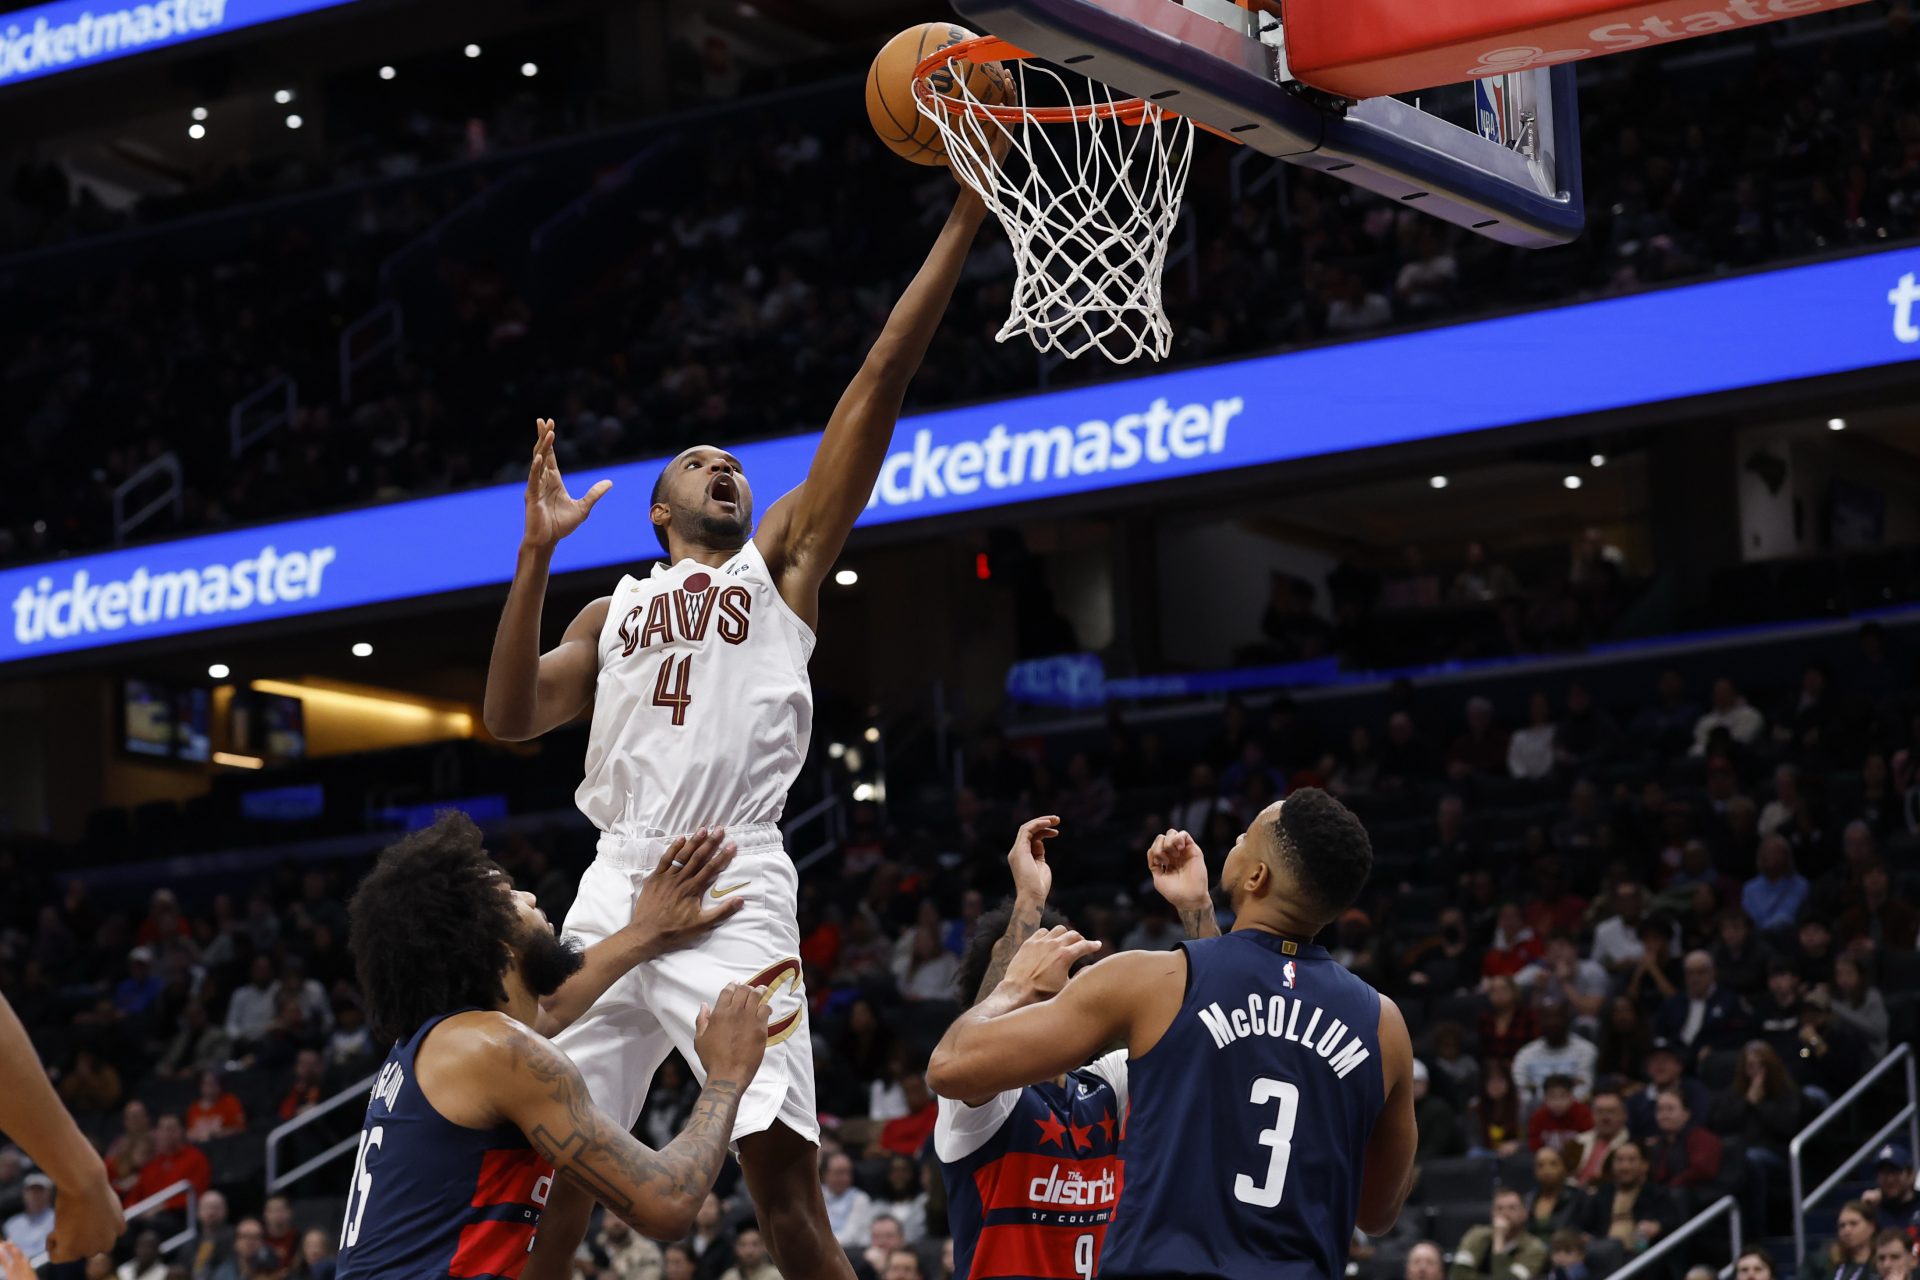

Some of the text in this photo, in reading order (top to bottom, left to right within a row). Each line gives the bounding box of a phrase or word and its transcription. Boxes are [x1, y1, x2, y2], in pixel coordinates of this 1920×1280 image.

[1480, 108, 1496, 136] NBA
[12, 546, 336, 643] ticketmaster
[618, 586, 752, 657] CAVS
[652, 652, 693, 726] 4
[1197, 993, 1370, 1079] McCOLLUM
[1234, 1077, 1300, 1208] 3
[1032, 1212, 1047, 1221] OF
